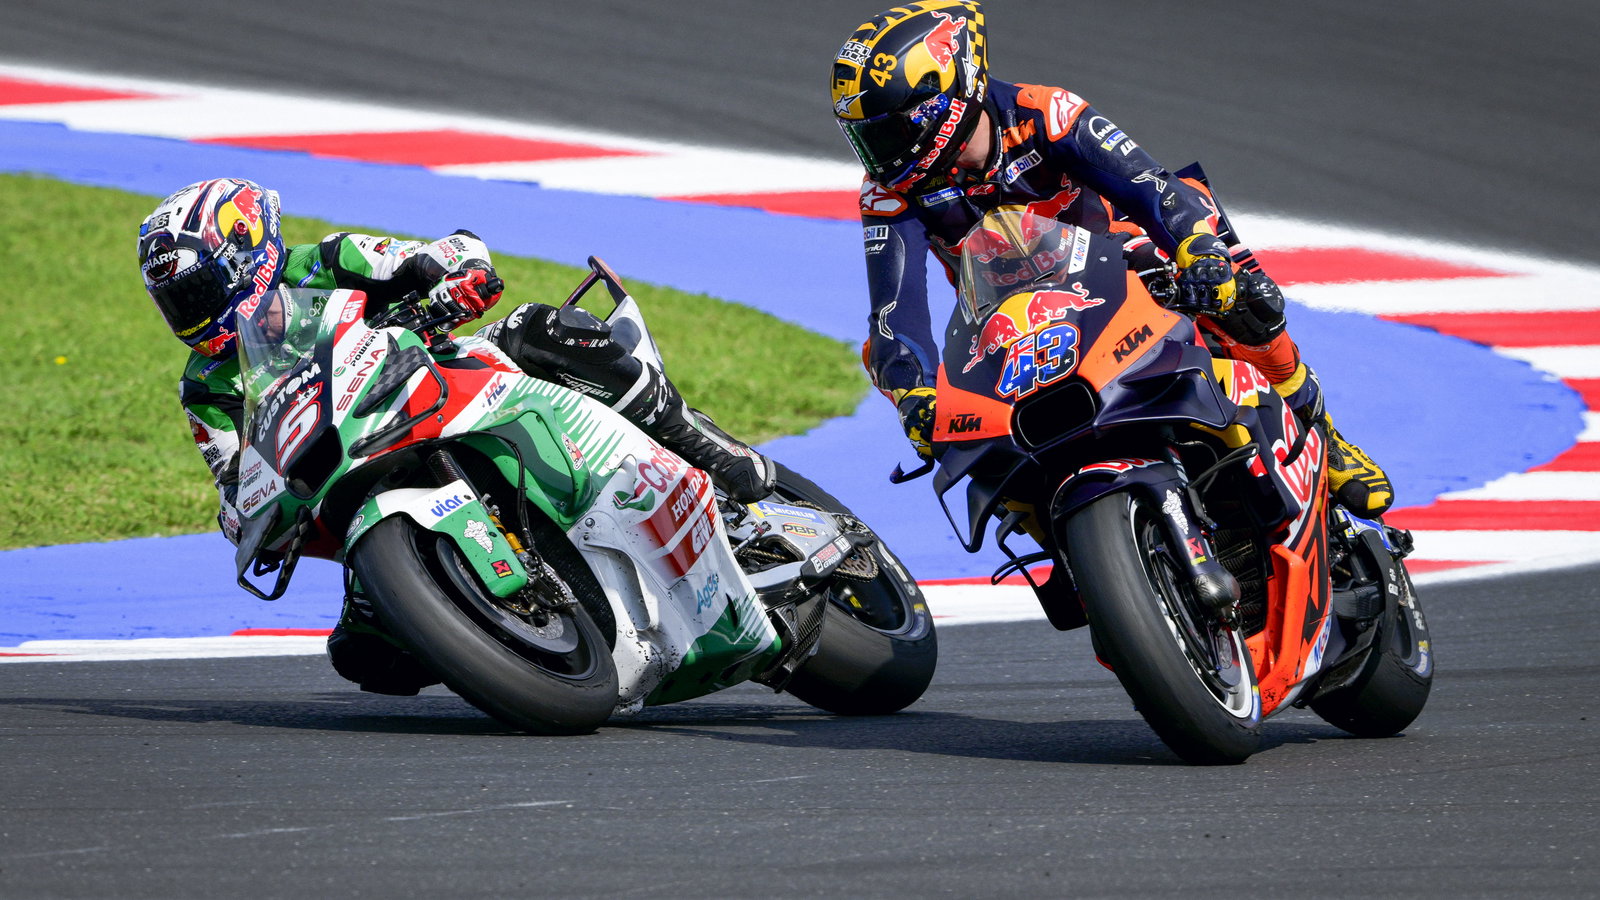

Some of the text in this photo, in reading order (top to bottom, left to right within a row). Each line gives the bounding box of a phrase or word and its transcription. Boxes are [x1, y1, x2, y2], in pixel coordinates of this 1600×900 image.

[869, 52, 898, 88] 43
[863, 227, 877, 240] obil
[142, 249, 180, 272] SHARK
[172, 262, 203, 282] WINGS
[343, 330, 373, 364] Castrol
[1112, 323, 1154, 364] KTM
[995, 321, 1081, 401] 43
[336, 348, 386, 411] SENA
[258, 362, 321, 442] CUSTOM
[275, 382, 324, 477] 5
[947, 413, 982, 434] KTM
[243, 479, 277, 513] SENA
[671, 470, 706, 522] HONDA
[773, 506, 817, 520] MICHELIN
[823, 552, 842, 569] GROUP
